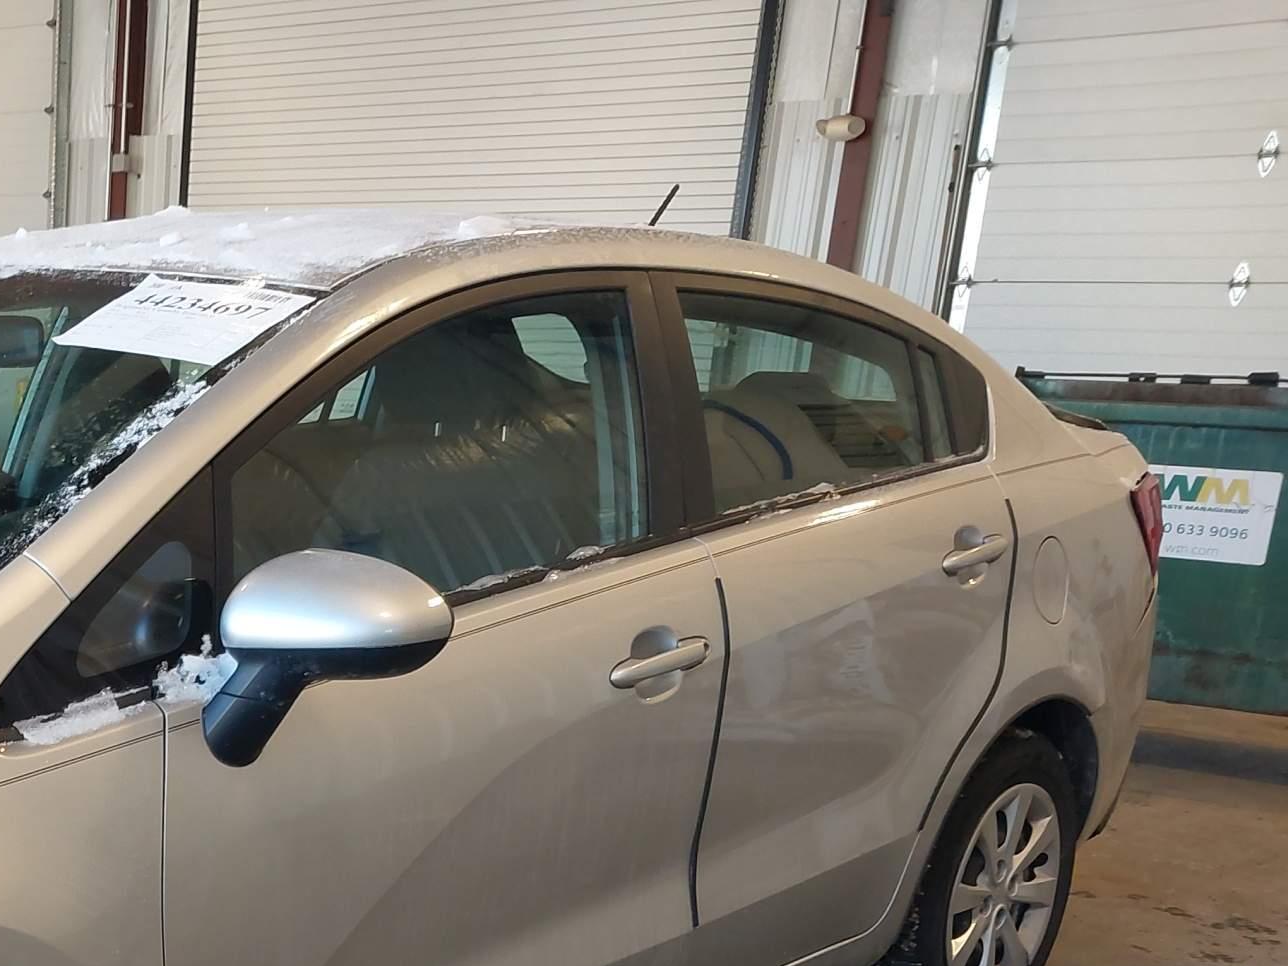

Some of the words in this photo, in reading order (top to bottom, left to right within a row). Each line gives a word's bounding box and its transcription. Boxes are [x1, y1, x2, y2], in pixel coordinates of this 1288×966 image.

[134, 293, 272, 319] 44234697
[1153, 473, 1251, 506] WM
[1176, 523, 1205, 536] 633
[1209, 526, 1249, 540] 9096
